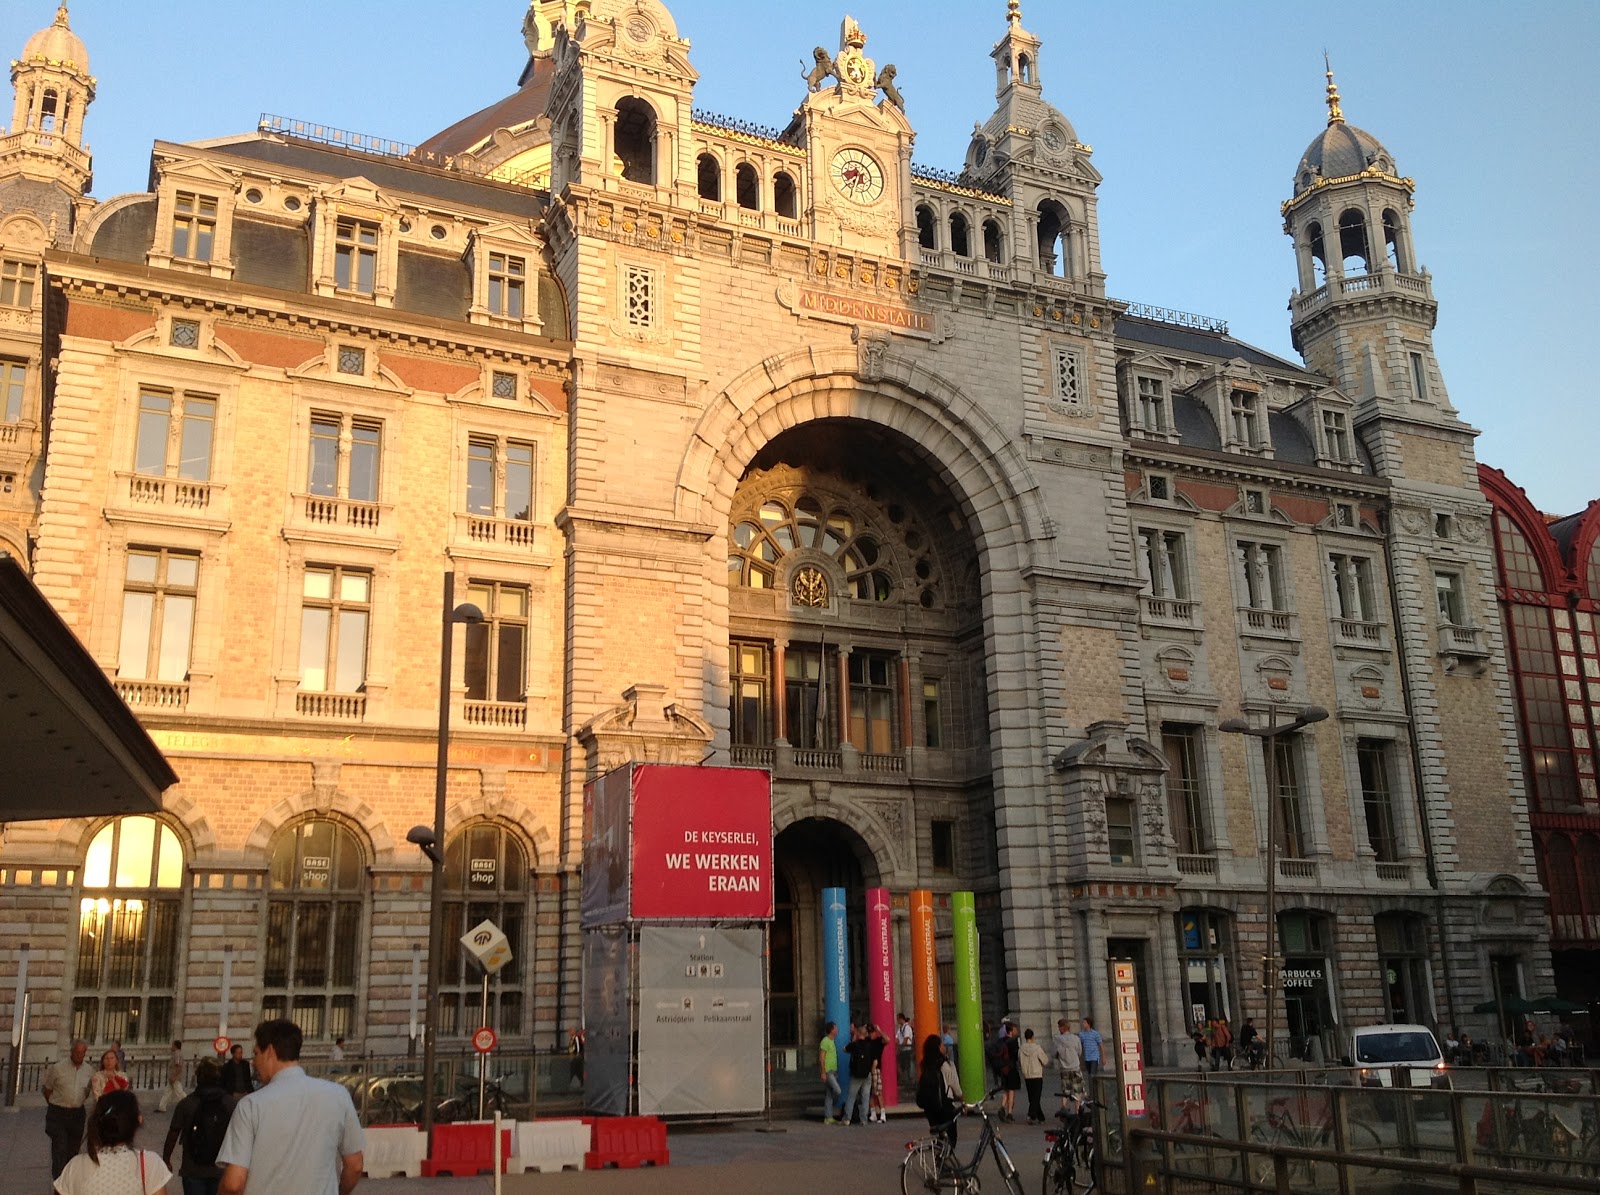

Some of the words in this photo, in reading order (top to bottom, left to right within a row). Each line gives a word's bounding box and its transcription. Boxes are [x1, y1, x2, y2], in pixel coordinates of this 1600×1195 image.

[804, 292, 930, 329] MIDDENSTATIE
[684, 831, 699, 843] DE
[702, 831, 759, 846] KEYSERLEI,
[306, 859, 328, 868] BASE
[473, 861, 493, 869] BASE
[665, 853, 691, 869] WE
[695, 854, 760, 870] WERKEN
[303, 870, 328, 882] shop
[471, 872, 494, 885] shop
[709, 875, 760, 892] ERAAN
[837, 916, 846, 1003] ANTWERPEN-CENTRAAL
[924, 918, 935, 1003] ANTWERPEN-CENTRAAL
[967, 920, 977, 1003] ANTWERPEN-CENTRAAL
